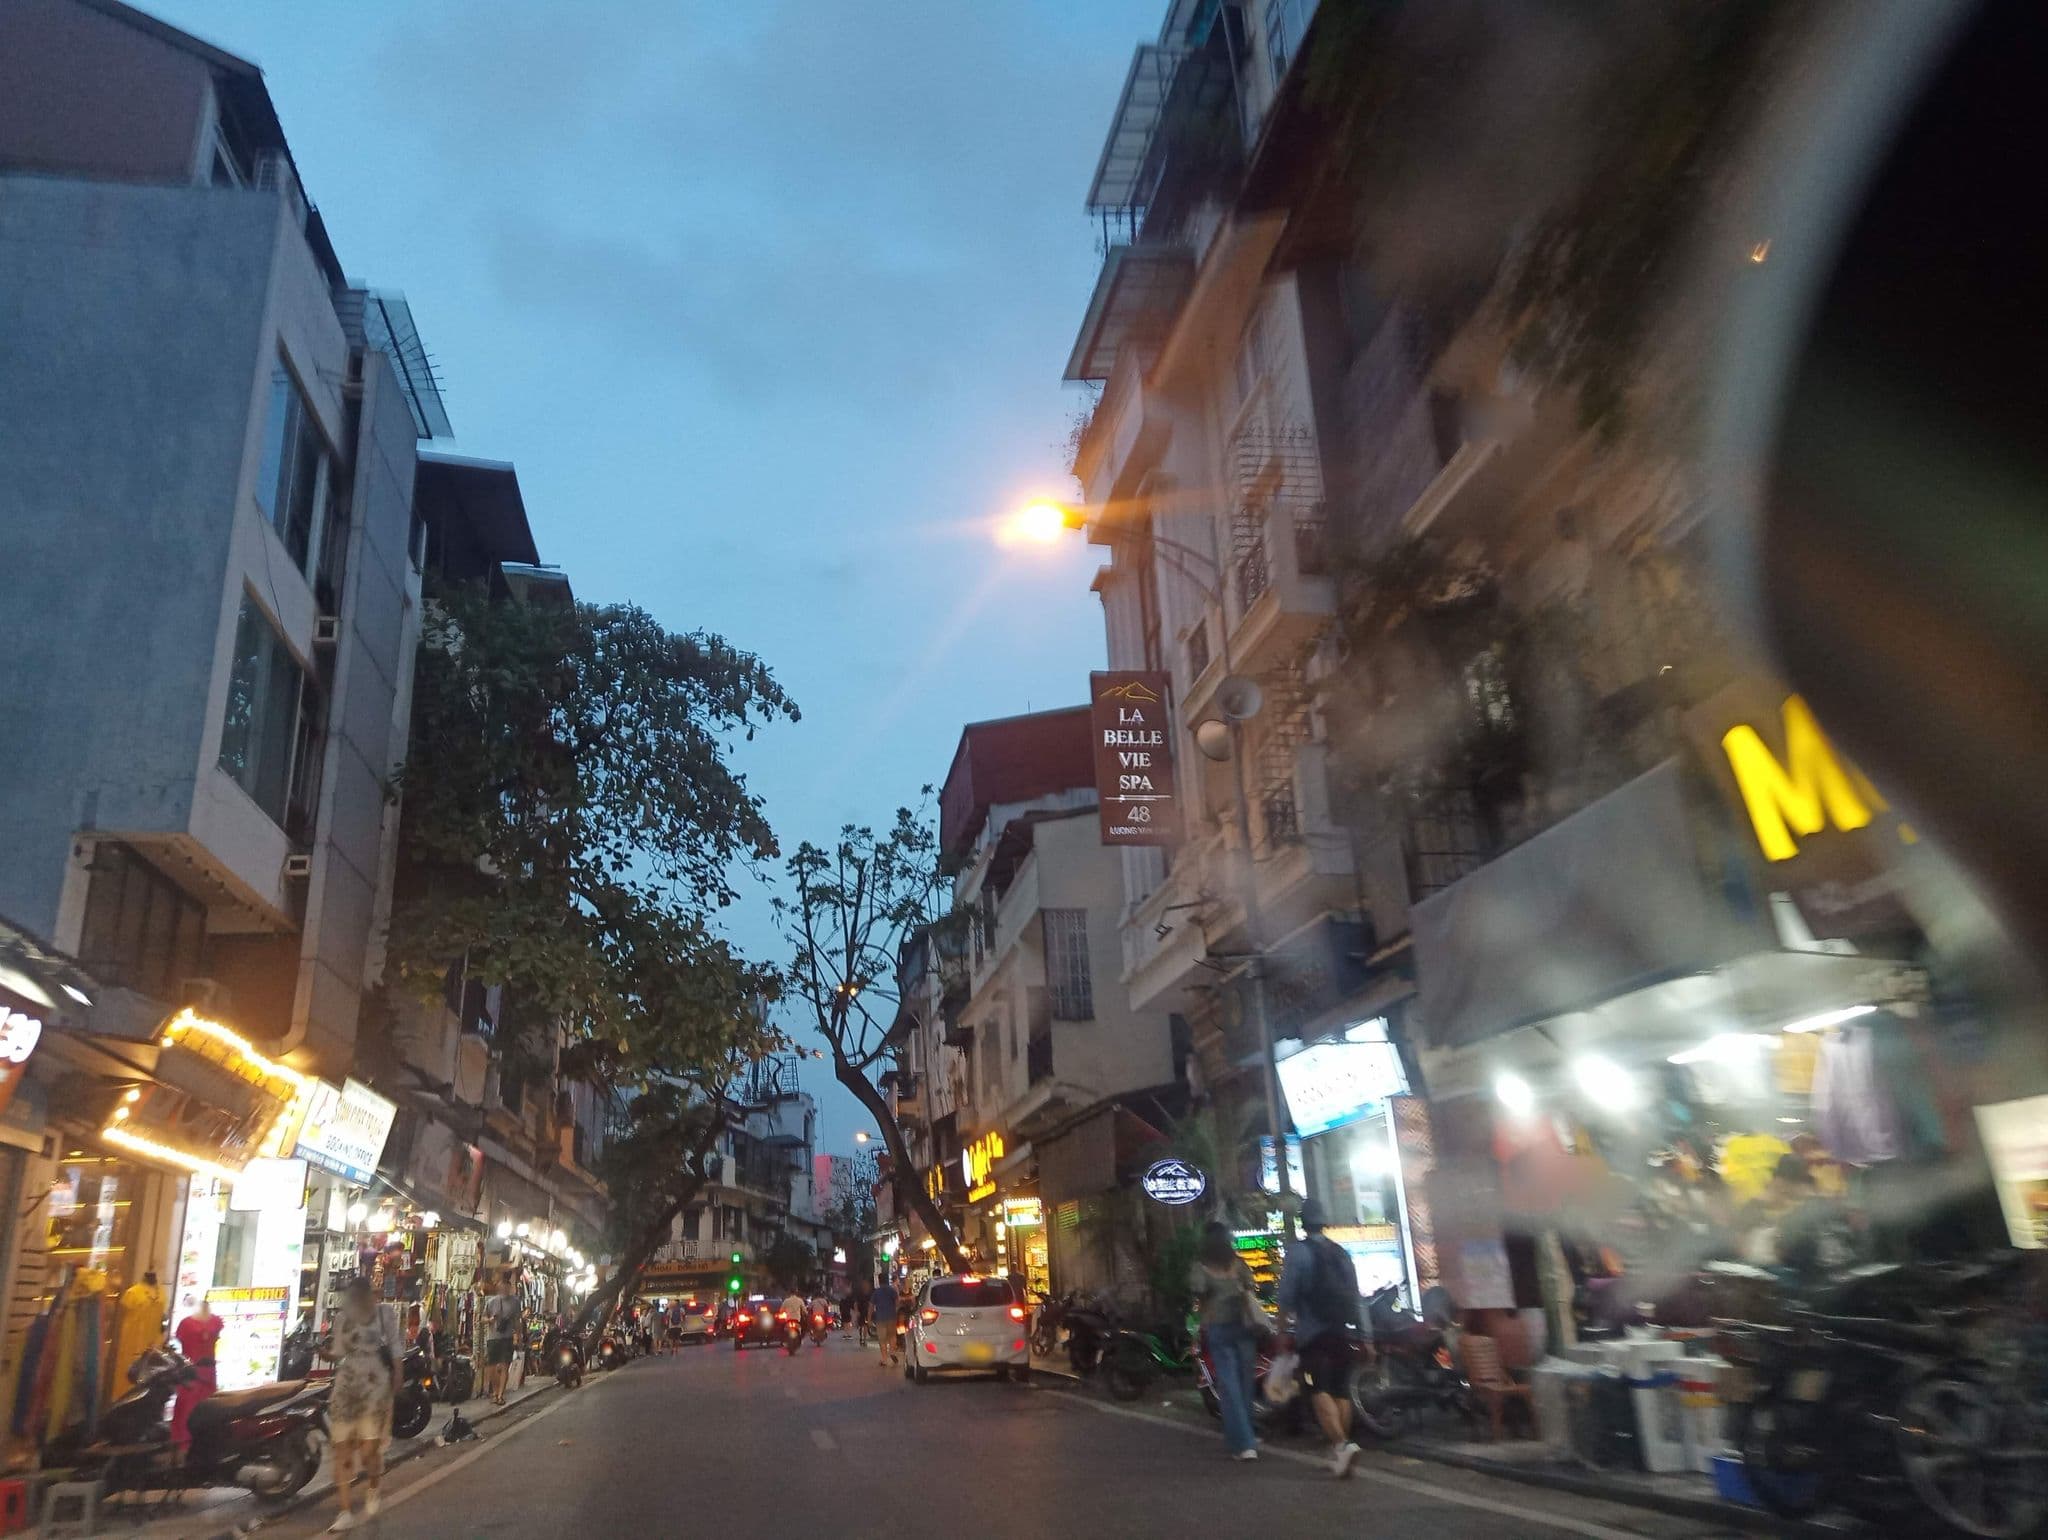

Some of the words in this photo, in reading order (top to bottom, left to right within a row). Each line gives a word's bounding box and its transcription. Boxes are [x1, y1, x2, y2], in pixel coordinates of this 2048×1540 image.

[1119, 707, 1145, 722] LA
[1103, 729, 1163, 746] BELLE
[1118, 752, 1152, 769] VIE
[1119, 774, 1154, 791] SPA
[1127, 805, 1151, 823] 48
